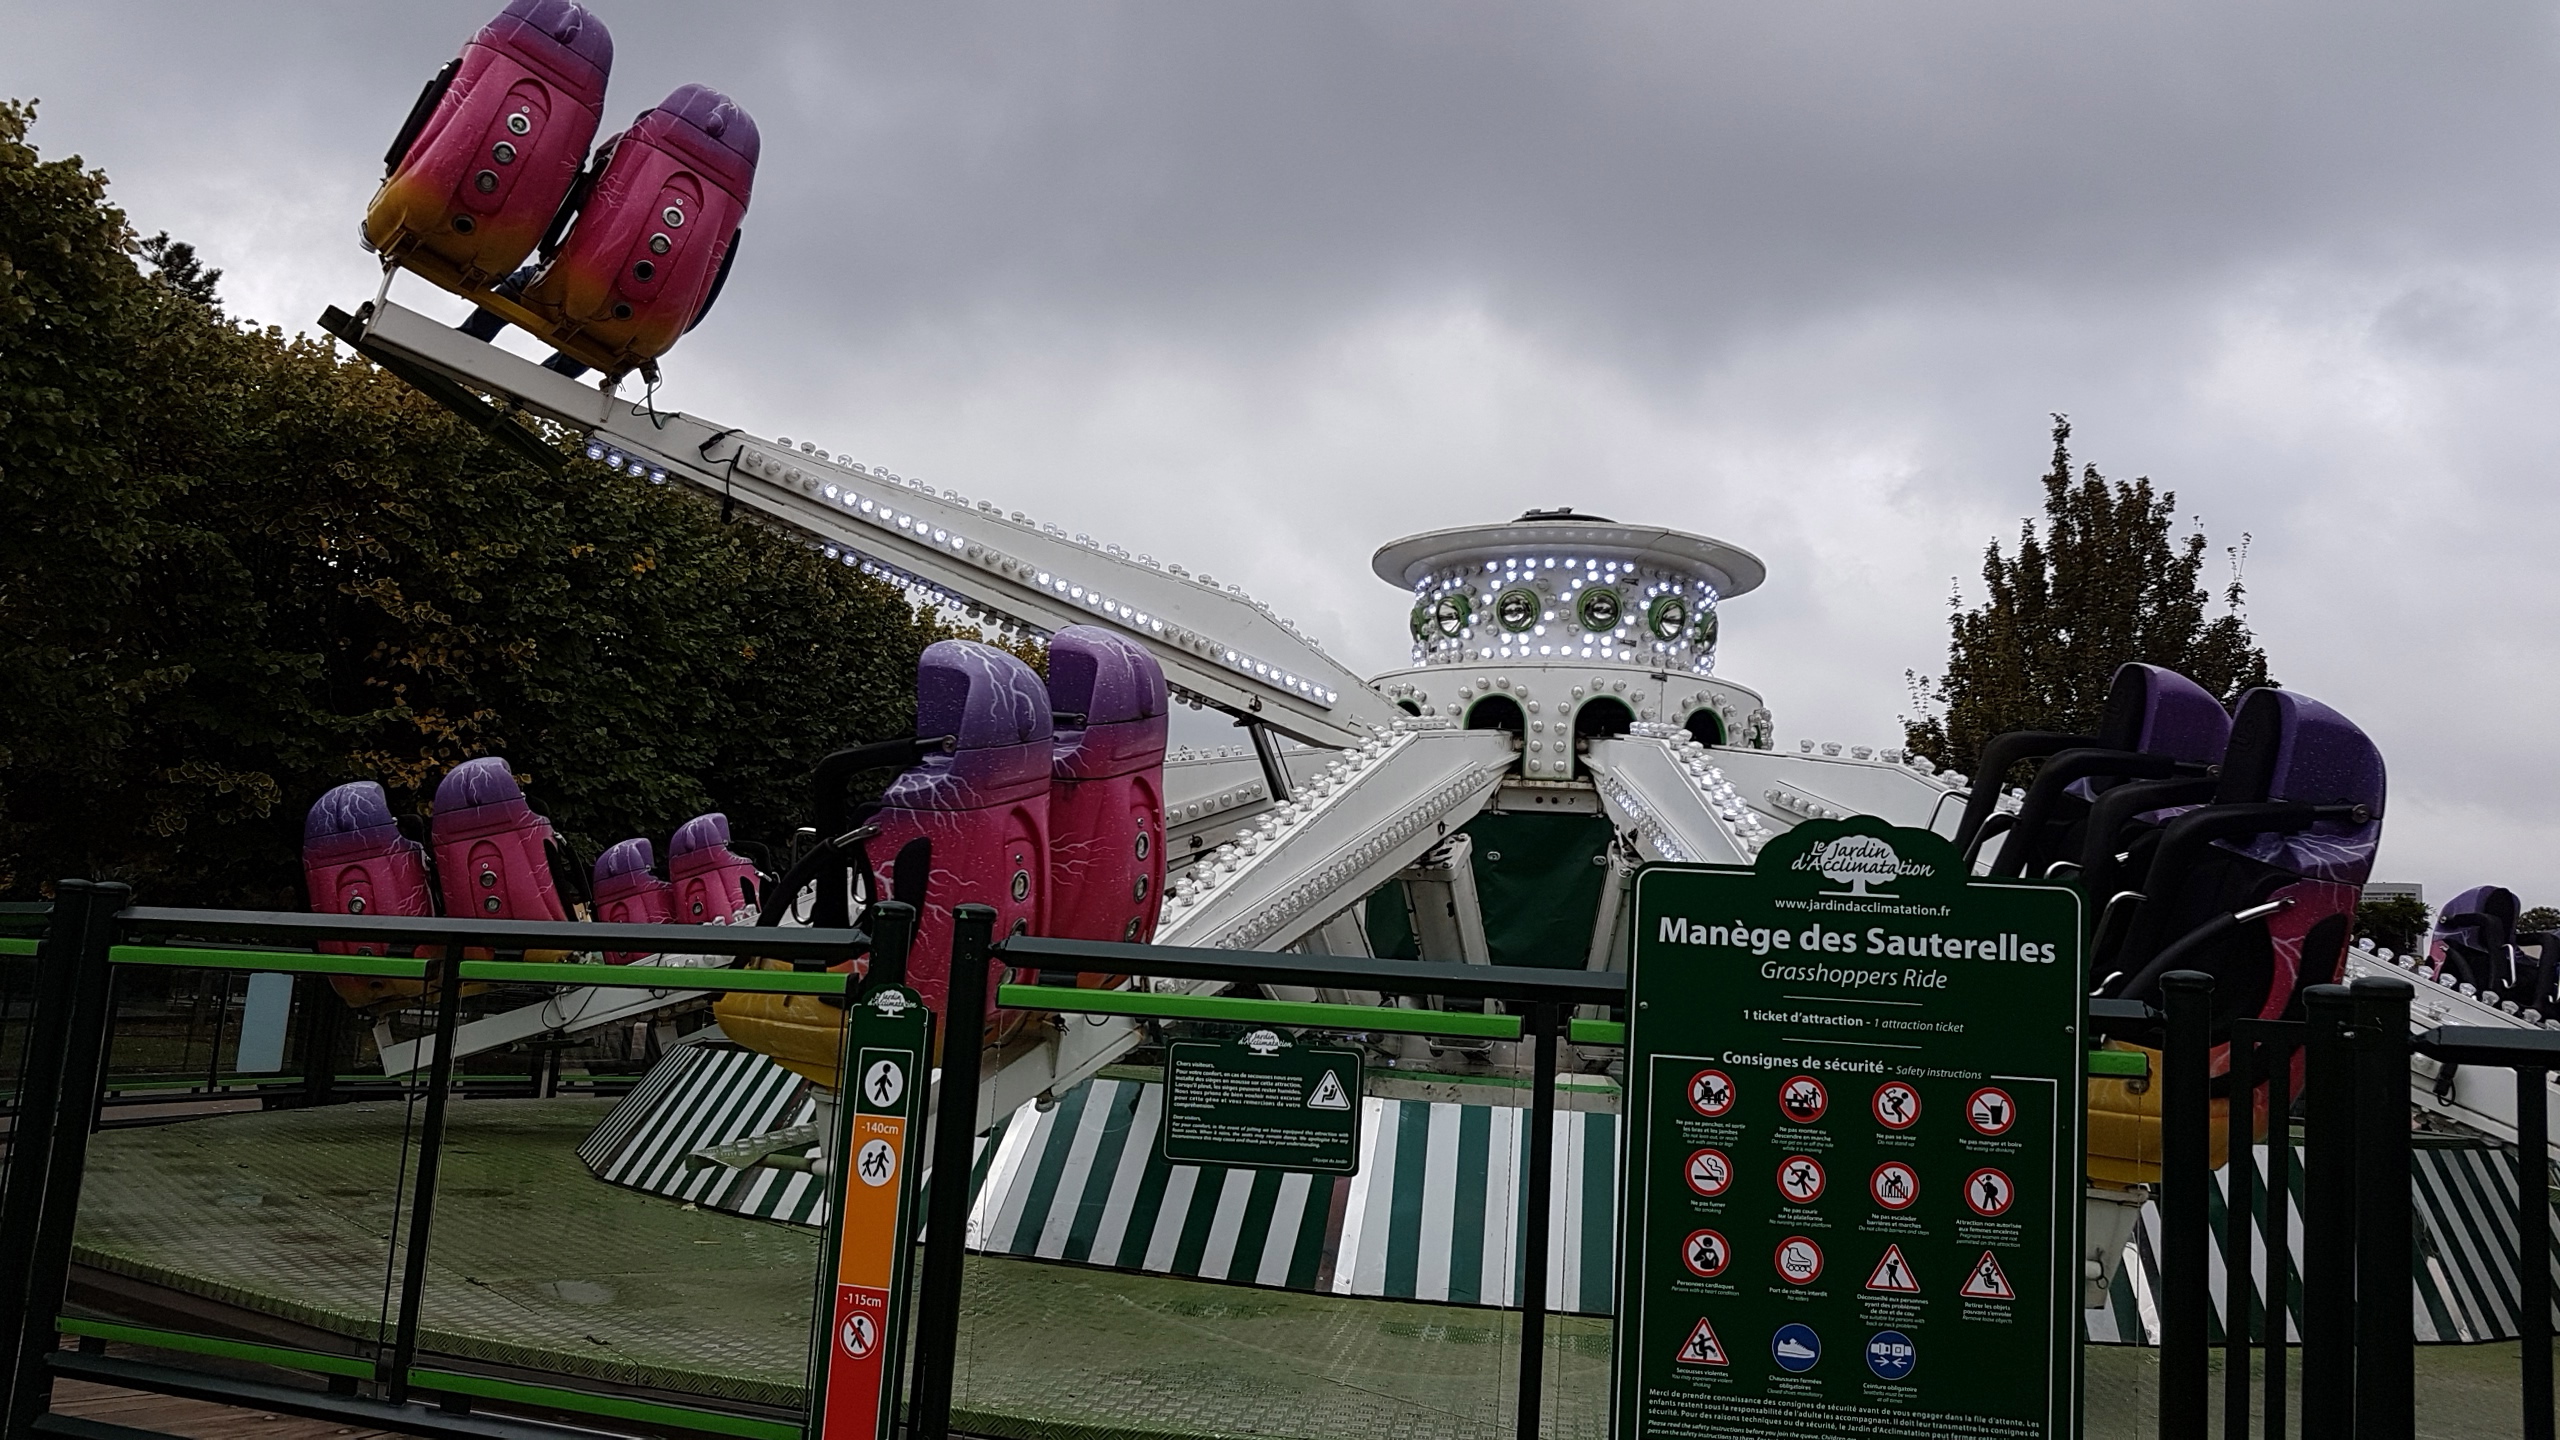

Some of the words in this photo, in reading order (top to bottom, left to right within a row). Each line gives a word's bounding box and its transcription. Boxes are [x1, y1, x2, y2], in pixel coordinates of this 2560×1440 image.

[1810, 840, 1828, 854] Le
[1829, 840, 1890, 860] Jardin
[1791, 852, 1935, 878] d'Acclimatation
[1775, 897, 1951, 917] www.jardindacclimatation.fr
[1659, 916, 1790, 956] Manège
[1800, 923, 1858, 953] des
[1867, 926, 2056, 963] Sauterelles
[1761, 960, 1898, 990] Grasshoppers
[1903, 968, 1948, 988] Ride
[1743, 1007, 1750, 1020] 1
[1753, 1007, 1788, 1022] ticket
[1790, 1010, 1863, 1026] d'attraction
[1873, 1015, 1879, 1028] 1
[1882, 1016, 1933, 1031] attraction
[1936, 1019, 1964, 1033] ticket
[1723, 1049, 1799, 1070] Consignes
[1802, 1055, 1821, 1070] de
[1824, 1057, 1884, 1074] sécurité
[1895, 1061, 1925, 1081] Safety
[1927, 1063, 1982, 1080] instructions
[861, 1121, 899, 1134] -140cm
[844, 1293, 882, 1307] -115cm
[1649, 1398, 1676, 1406] enfants
[1730, 1406, 1782, 1415] responsabilité
[1794, 1410, 1822, 1418] l'adulte
[1835, 1415, 1892, 1425] accompagnant.
[1932, 1421, 1977, 1432] transmettre
[1990, 1428, 2028, 1437] consignes
[1650, 1388, 1669, 1396] Merci
[1713, 1395, 1761, 1404] connaissance
[1778, 1400, 1814, 1409] consignes
[1828, 1403, 1857, 1412] sécurité
[1912, 1412, 1943, 1420] engager
[1945, 1413, 1963, 1421] dans
[1988, 1416, 2025, 1426] d'attente.
[1648, 1408, 1679, 1416] sécurité.
[1714, 1413, 1740, 1421] raisons
[1741, 1415, 1782, 1425] techniques
[1806, 1421, 1837, 1431] sécurité,
[1848, 1424, 1870, 1432] Jardin
[1872, 1426, 1930, 1437] d'Acclimatation
